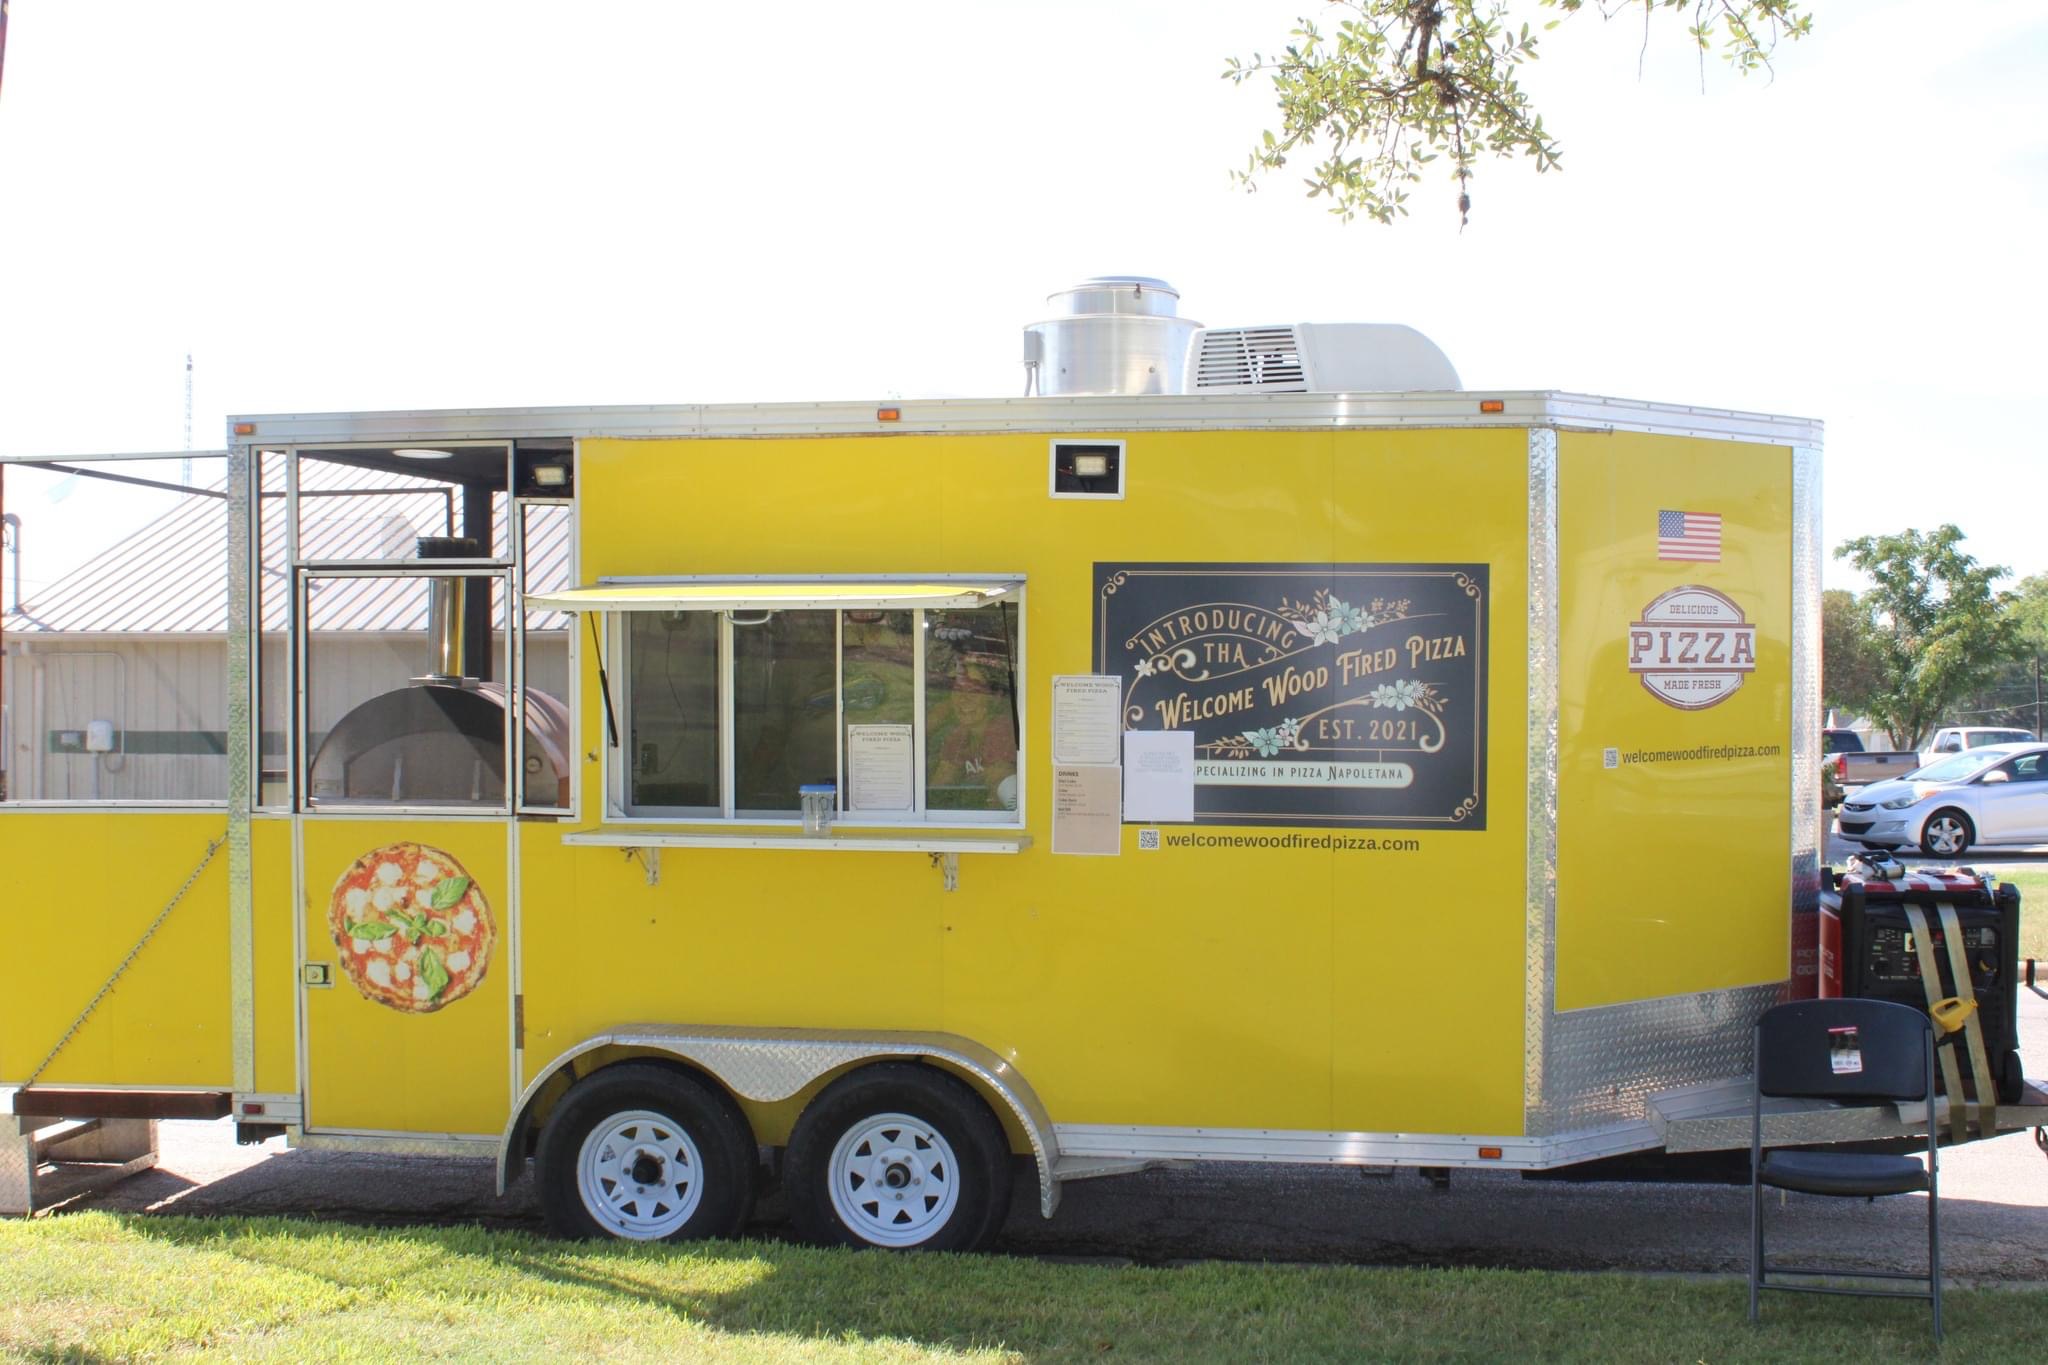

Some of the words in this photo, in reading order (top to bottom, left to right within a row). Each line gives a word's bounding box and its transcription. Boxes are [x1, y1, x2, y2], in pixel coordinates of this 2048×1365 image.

[1669, 604, 1719, 615] DELICIOUS
[1139, 607, 1298, 655] INTRODUCING
[1203, 643, 1251, 668] THA
[1630, 631, 1755, 664] PIZZA
[1155, 686, 1255, 730] WELCOME
[1262, 665, 1329, 707] WOOD
[1336, 648, 1397, 685] FIRED
[1405, 634, 1466, 669] PIZZA
[1663, 679, 1690, 690] MADE
[1692, 679, 1722, 690] FRESH
[1319, 721, 1362, 741] EST.
[1370, 719, 1418, 741] 2021
[1622, 745, 1781, 764] welcomewoodfiredpizza.com
[1193, 765, 1267, 778] PECIALIZING
[1273, 765, 1284, 777] IN
[1290, 765, 1323, 778] PIZZA
[1166, 832, 1420, 853] welcomewoodfiredpizza.com
